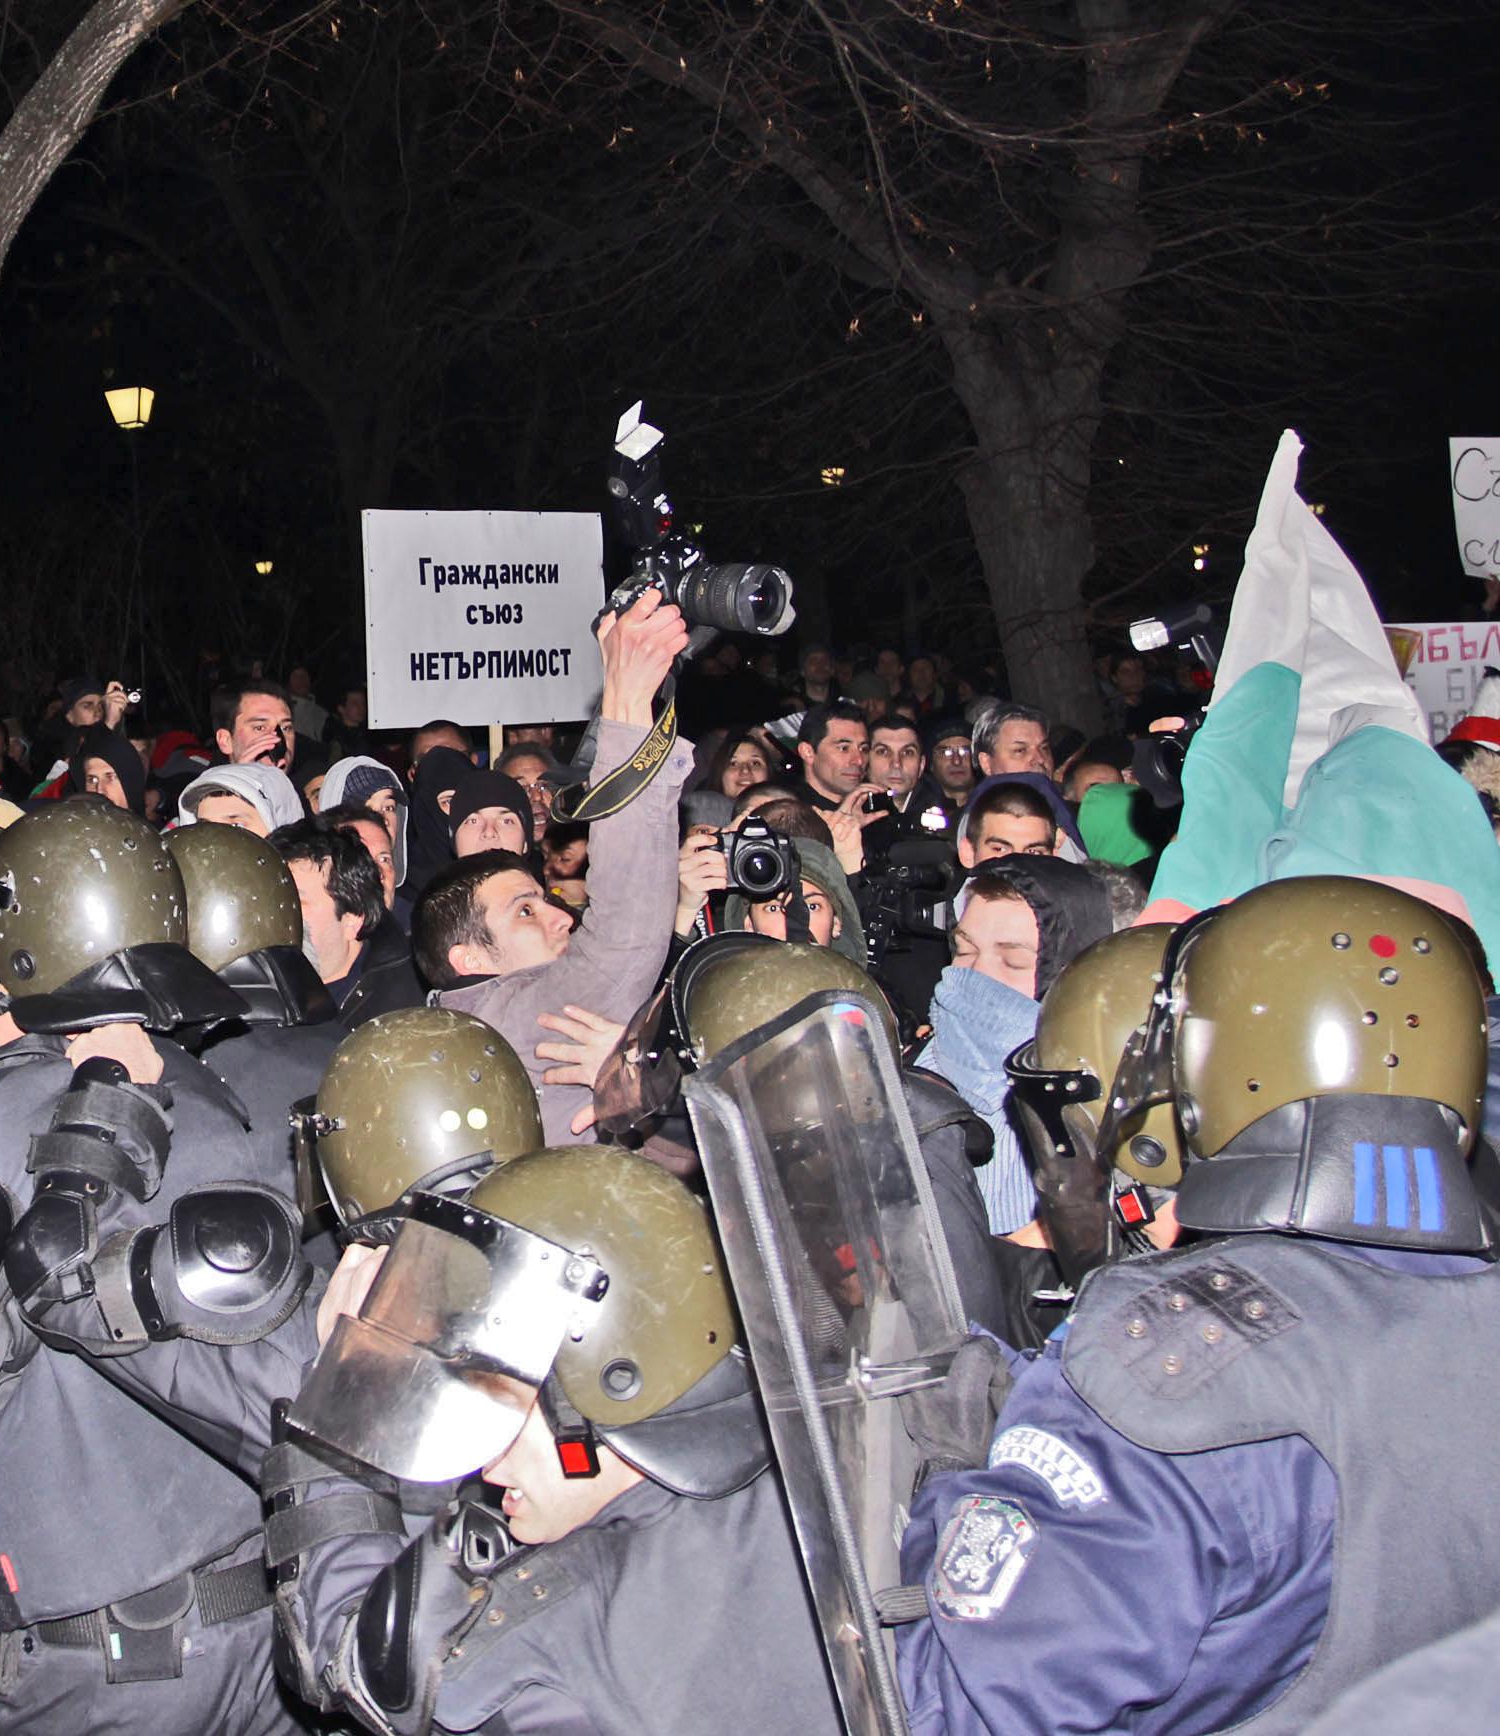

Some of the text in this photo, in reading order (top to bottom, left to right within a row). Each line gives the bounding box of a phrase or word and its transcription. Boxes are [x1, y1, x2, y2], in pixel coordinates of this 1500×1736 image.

[418, 557, 559, 593] Граждански
[466, 603, 523, 625] съюз
[410, 648, 571, 681] НЕТЪРПИМОСТ
